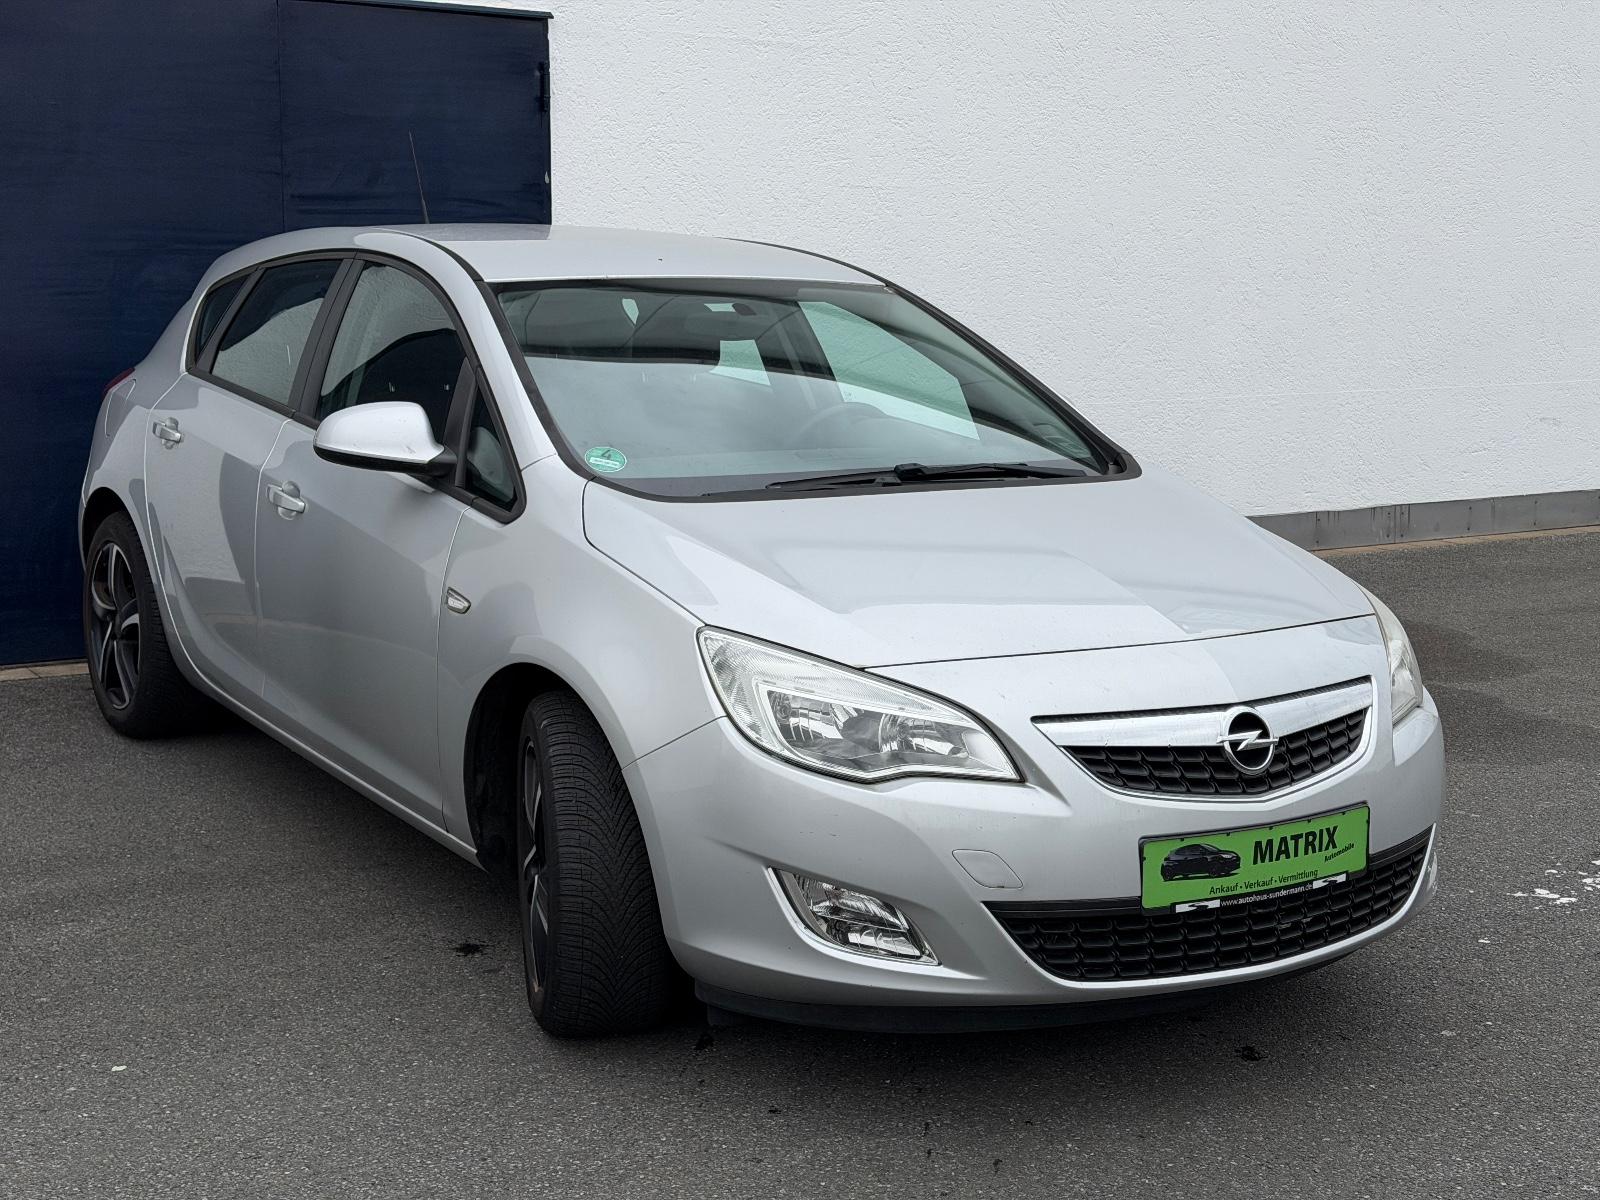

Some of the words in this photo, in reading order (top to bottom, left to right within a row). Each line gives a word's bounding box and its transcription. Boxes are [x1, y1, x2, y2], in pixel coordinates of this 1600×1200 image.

[601, 449, 612, 460] 4
[1252, 825, 1339, 865] MATRIX
[1324, 842, 1355, 863] Automobile
[1209, 884, 1239, 895] Ankauf
[1244, 877, 1273, 890] Verkauf
[1278, 868, 1319, 884] Vermittlung
[1220, 882, 1313, 907] www.autohaus-sundermann.de
